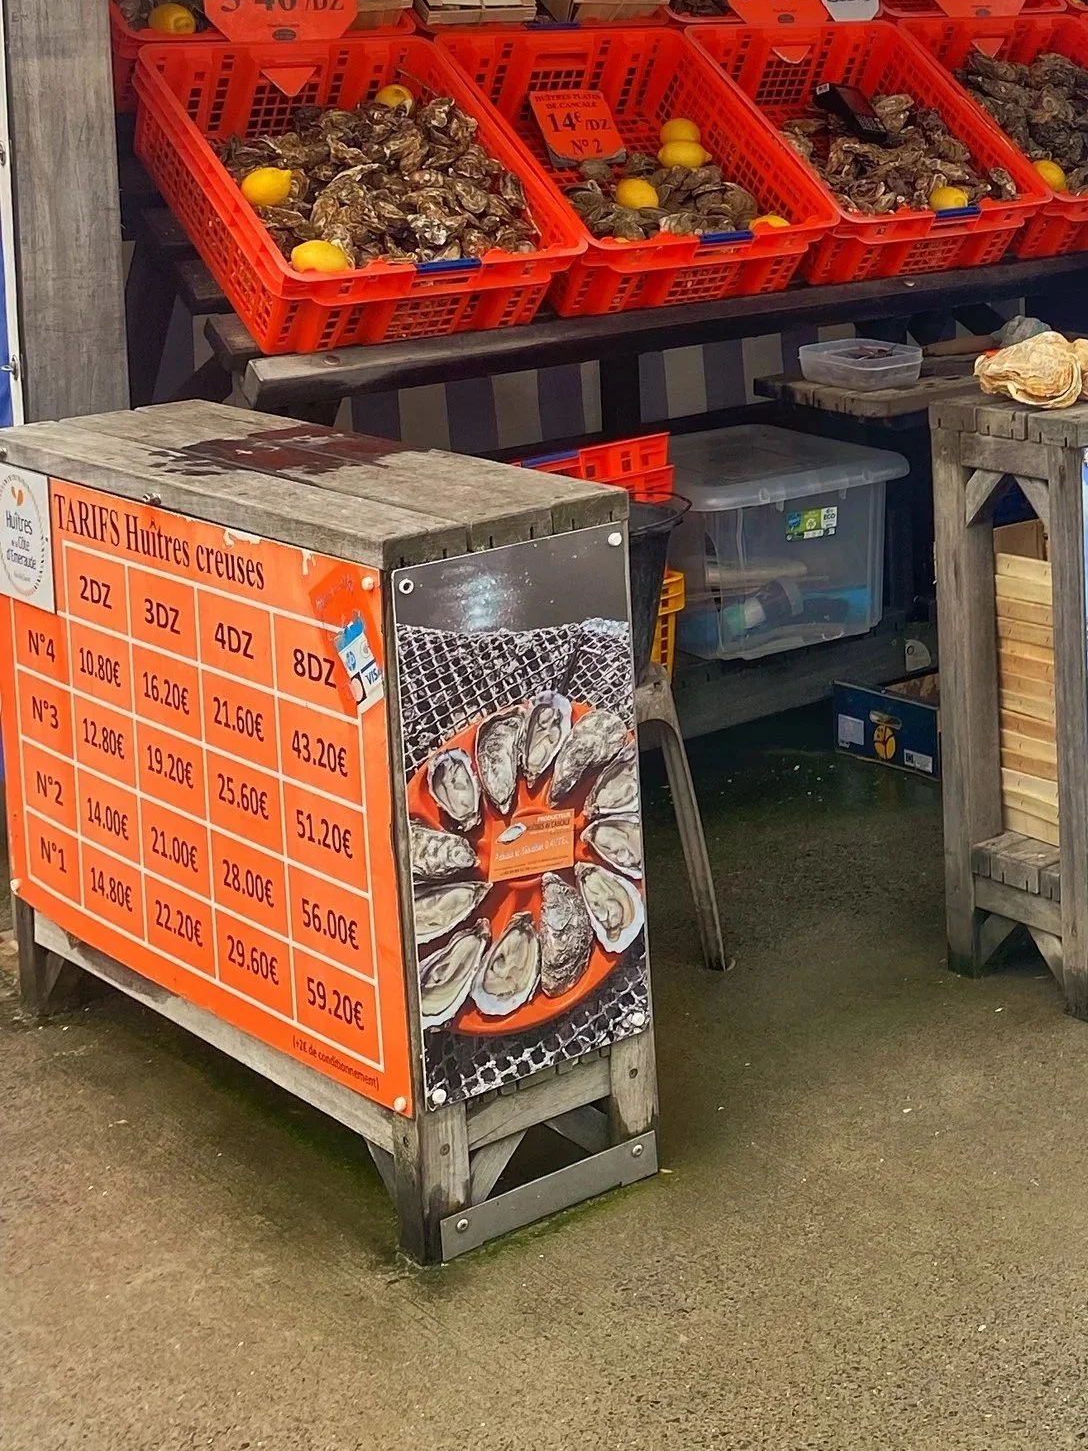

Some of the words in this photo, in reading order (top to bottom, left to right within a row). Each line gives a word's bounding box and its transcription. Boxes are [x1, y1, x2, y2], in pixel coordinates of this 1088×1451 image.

[547, 110, 582, 133] 14€
[592, 138, 603, 154] 2
[5, 509, 33, 536] Huîtres
[54, 493, 120, 547] TARIFS
[124, 513, 190, 569] Huîtres
[195, 543, 265, 591] creuses
[79, 575, 112, 610] 2DZ
[144, 597, 181, 635] 3DZ
[214, 622, 254, 661] 4DZ
[293, 648, 337, 689] 8DZ
[28, 629, 56, 663] N°4
[79, 647, 121, 688] 10.80€
[143, 671, 190, 716] 16.20€
[213, 696, 264, 743] 21.60€
[291, 729, 348, 778] 43.20€
[31, 695, 59, 730] N°3
[83, 717, 125, 760] 12.80€
[147, 744, 194, 790] 19.20€
[217, 772, 269, 821] 25.60€
[296, 809, 353, 860] 51.20€
[36, 770, 64, 807] N°2
[87, 797, 129, 841] 14.00€
[150, 826, 199, 873] 21.00€
[222, 859, 275, 908] 28.00€
[301, 897, 360, 951] 56.00€
[40, 836, 67, 874] N°1
[90, 867, 133, 913] 14.80€
[155, 899, 203, 948] 22.20€
[226, 934, 280, 986] 29.60€
[306, 976, 365, 1031] 59.20€
[308, 1044, 317, 1058] de
